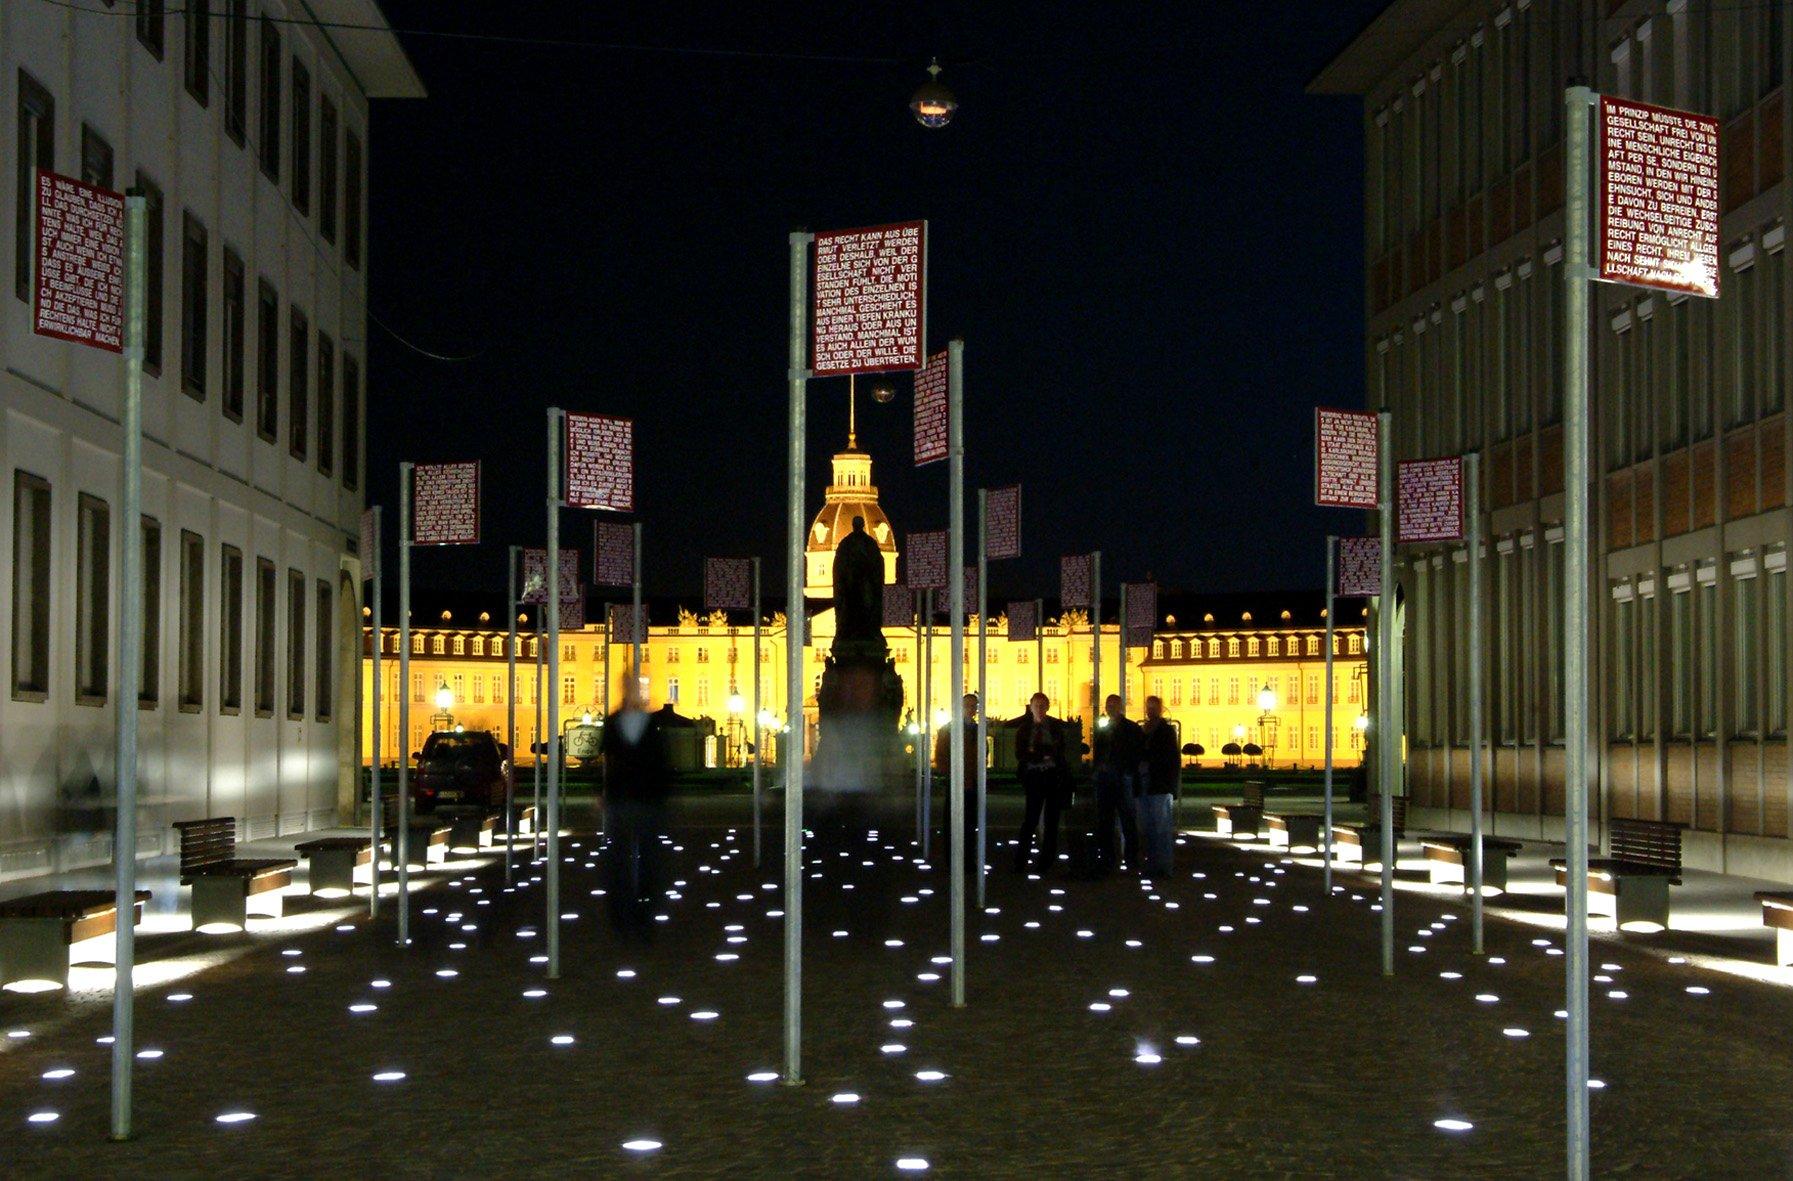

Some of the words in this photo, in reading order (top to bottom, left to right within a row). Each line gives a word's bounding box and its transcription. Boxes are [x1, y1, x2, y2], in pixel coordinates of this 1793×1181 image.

[1606, 104, 1616, 114] IM
[1619, 106, 1648, 121] PRINZIP
[1652, 111, 1682, 127] MÜSSTE
[1685, 119, 1697, 130] DIE
[1607, 115, 1669, 136] GESELLSCHAFT
[1672, 128, 1688, 140] FREI
[1690, 131, 1705, 143] VON
[1607, 126, 1635, 141] RECHT
[1660, 136, 1694, 152] UNRECHT
[1696, 143, 1707, 154] IST
[1708, 146, 1716, 156] KE
[1608, 138, 1622, 150] INE
[1626, 141, 1680, 160] MENSCHLICHE
[1683, 152, 1717, 167] EIGENSCH
[1608, 149, 1625, 162] AFT
[1628, 153, 1644, 165] PER
[1662, 159, 1697, 175] SONDERN
[1699, 166, 1711, 177] EIN
[1608, 172, 1642, 187] EBOREN
[1645, 179, 1678, 194] WERDEN
[1681, 185, 1694, 196] MIT
[1697, 188, 1711, 200] DER
[1713, 191, 1717, 201] S
[1646, 168, 1654, 178] IN
[1656, 170, 1672, 181] DEN
[1674, 173, 1688, 184] WIR
[1690, 176, 1717, 190] HINEING
[1608, 195, 1614, 205] E
[1618, 196, 1645, 210] DAVON
[1648, 202, 1658, 212] ZU
[1701, 211, 1718, 223] ERST
[1657, 192, 1674, 204] SICH
[1677, 196, 1692, 207] UND
[1695, 199, 1717, 212] ANDER
[1608, 206, 1622, 217] DIE
[1626, 209, 1692, 230] WECHSELSEITIGE
[1696, 221, 1717, 234] ZUSCH
[818, 237, 832, 246] DAS
[835, 234, 859, 244] RECHT
[861, 232, 882, 241] KANN
[885, 230, 900, 239] AUS
[902, 227, 918, 237] ÜBE
[1608, 217, 1645, 233] REIBUNG
[1648, 224, 1664, 236] VON
[1668, 228, 1703, 243] ANRECHT
[1705, 234, 1717, 245] AUF
[1608, 229, 1635, 242] RECHT
[1639, 233, 1687, 251] ERMÖGLICHT
[818, 246, 838, 255] RMUT
[842, 241, 879, 252] VERLETZT
[884, 237, 918, 248] WERDEN
[818, 255, 837, 264] ODER
[878, 248, 897, 258] WEIL
[901, 246, 918, 255] DER
[1608, 240, 1632, 253] EINES
[817, 262, 850, 273] EINZELNE
[853, 260, 871, 269] SICH
[873, 258, 889, 267] VON
[891, 256, 908, 265] DER
[911, 255, 918, 264] G
[1607, 251, 1630, 264] NACH
[817, 270, 867, 282] ESELLSCHAFT
[872, 267, 895, 276] NICHT
[900, 265, 917, 274] VER
[1606, 262, 1648, 278] LLSCHAFT
[816, 290, 841, 300] VATION
[844, 288, 859, 297] DES
[862, 284, 905, 295] EINZELNEN
[909, 283, 917, 291] IS
[817, 280, 849, 291] STANDEN
[880, 276, 893, 285] DIE
[897, 274, 917, 283] MOTI
[816, 306, 856, 317] MANCHMAL
[859, 302, 902, 314] GESCHIEHT
[906, 301, 916, 309] ES
[822, 299, 842, 308] SEHR
[816, 327, 826, 335] NG
[828, 324, 859, 334] HERAUS
[861, 322, 882, 331] ODER
[886, 320, 902, 329] AUS
[905, 319, 917, 328] UN
[817, 318, 830, 326] AUS
[832, 316, 853, 325] EINER
[856, 313, 881, 323] TIEFEN
[858, 330, 900, 340] MANCHMAL
[904, 328, 916, 337] IST
[828, 343, 848, 351] AUCH
[850, 340, 876, 350] ALLEIN
[879, 339, 894, 348] DER
[897, 337, 917, 346] WUN
[816, 353, 831, 361] SCH
[833, 351, 854, 360] ODER
[856, 350, 872, 358] DER
[903, 346, 916, 355] DIE
[816, 360, 848, 370] GESETZE
